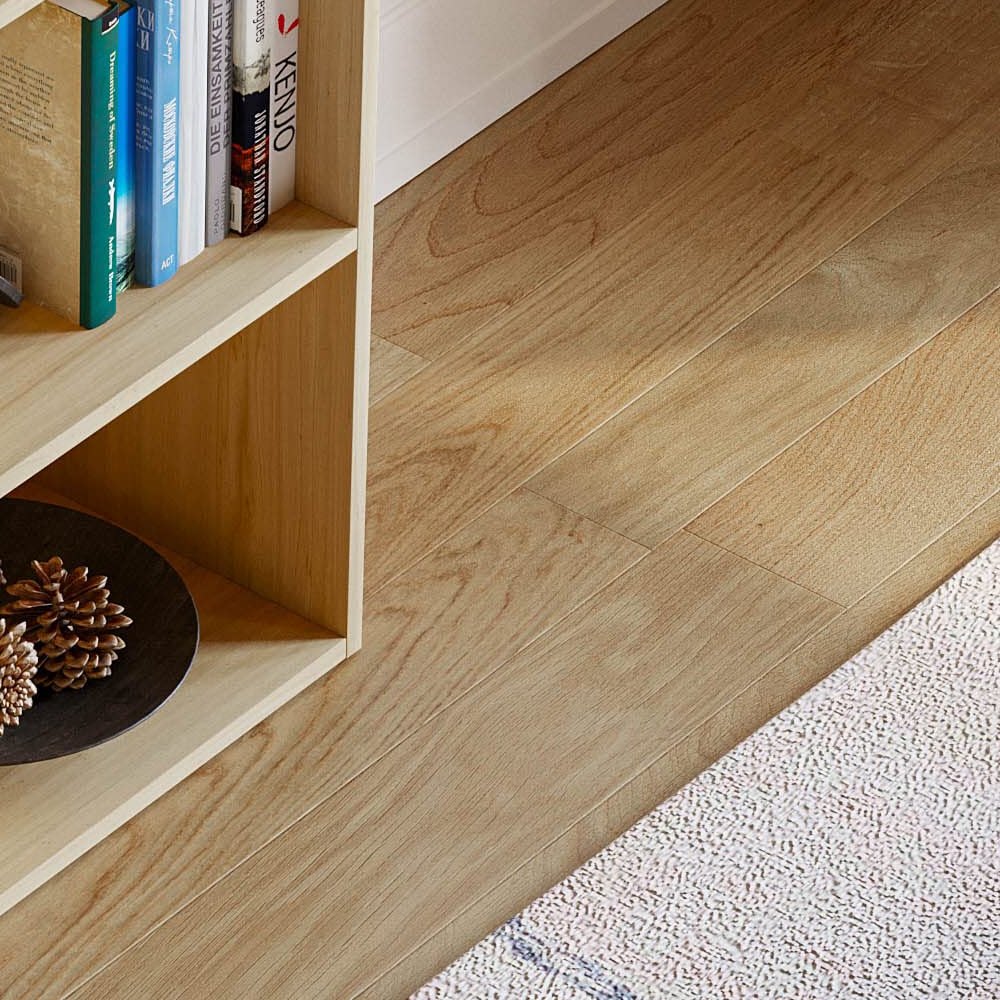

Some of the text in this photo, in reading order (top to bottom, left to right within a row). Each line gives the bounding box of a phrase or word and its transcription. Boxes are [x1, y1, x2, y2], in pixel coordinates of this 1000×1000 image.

[108, 51, 116, 110] Dreaming
[108, 110, 116, 122] of
[211, 3, 222, 156] DIE EINSAMKEIT
[274, 52, 296, 152] KENJO
[223, 106, 231, 149] DER
[253, 109, 266, 224] JONATHAN STANDFORD
